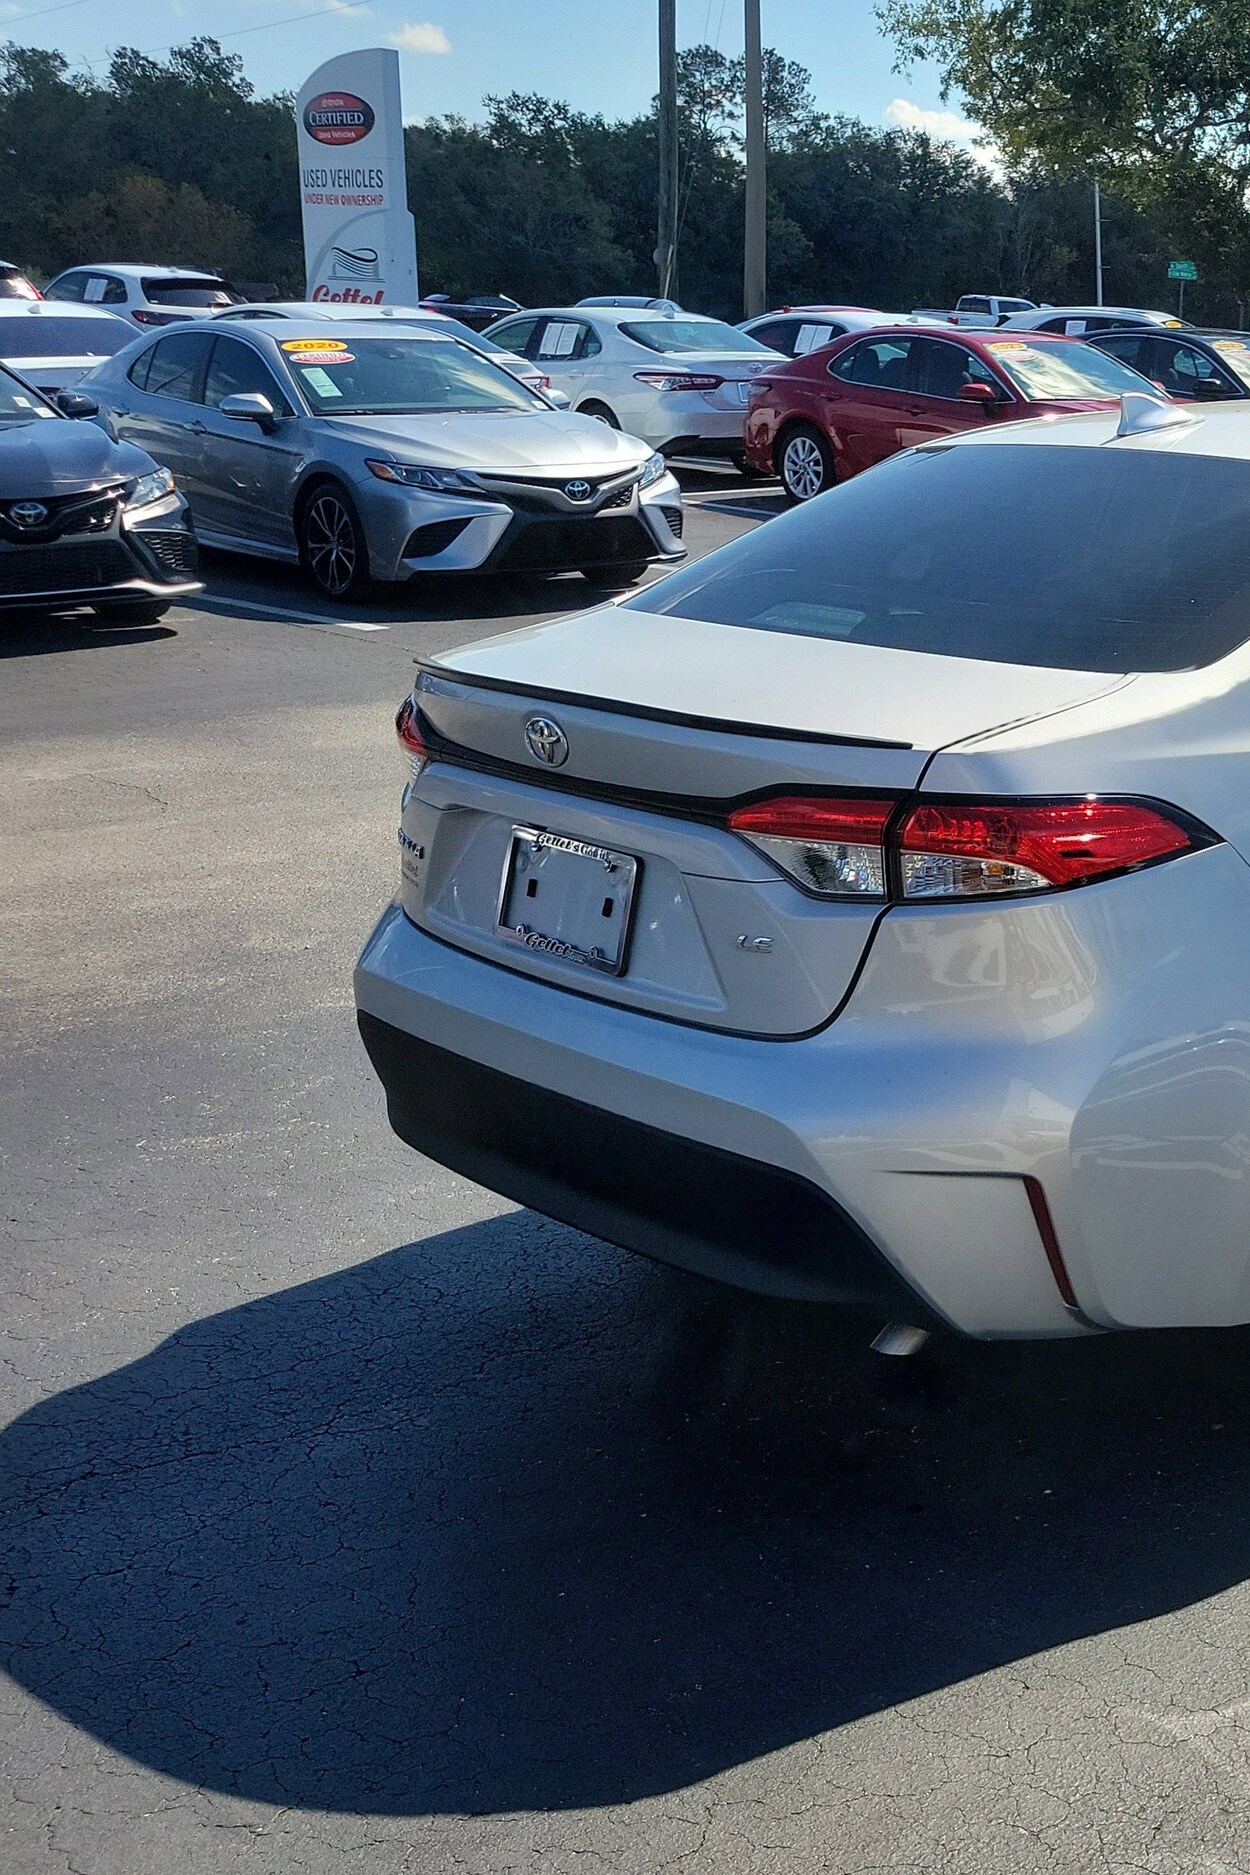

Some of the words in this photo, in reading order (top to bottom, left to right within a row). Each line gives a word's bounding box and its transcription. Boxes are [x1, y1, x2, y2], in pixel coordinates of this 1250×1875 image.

[309, 110, 364, 126] CERTIFIED
[303, 169, 327, 188] USED
[329, 169, 384, 188] VEHICLES
[304, 193, 323, 205] UNDER
[325, 193, 339, 205] NEW
[340, 193, 384, 206] OWNERSHIP
[291, 342, 338, 350] 2020
[736, 934, 774, 953] LE
